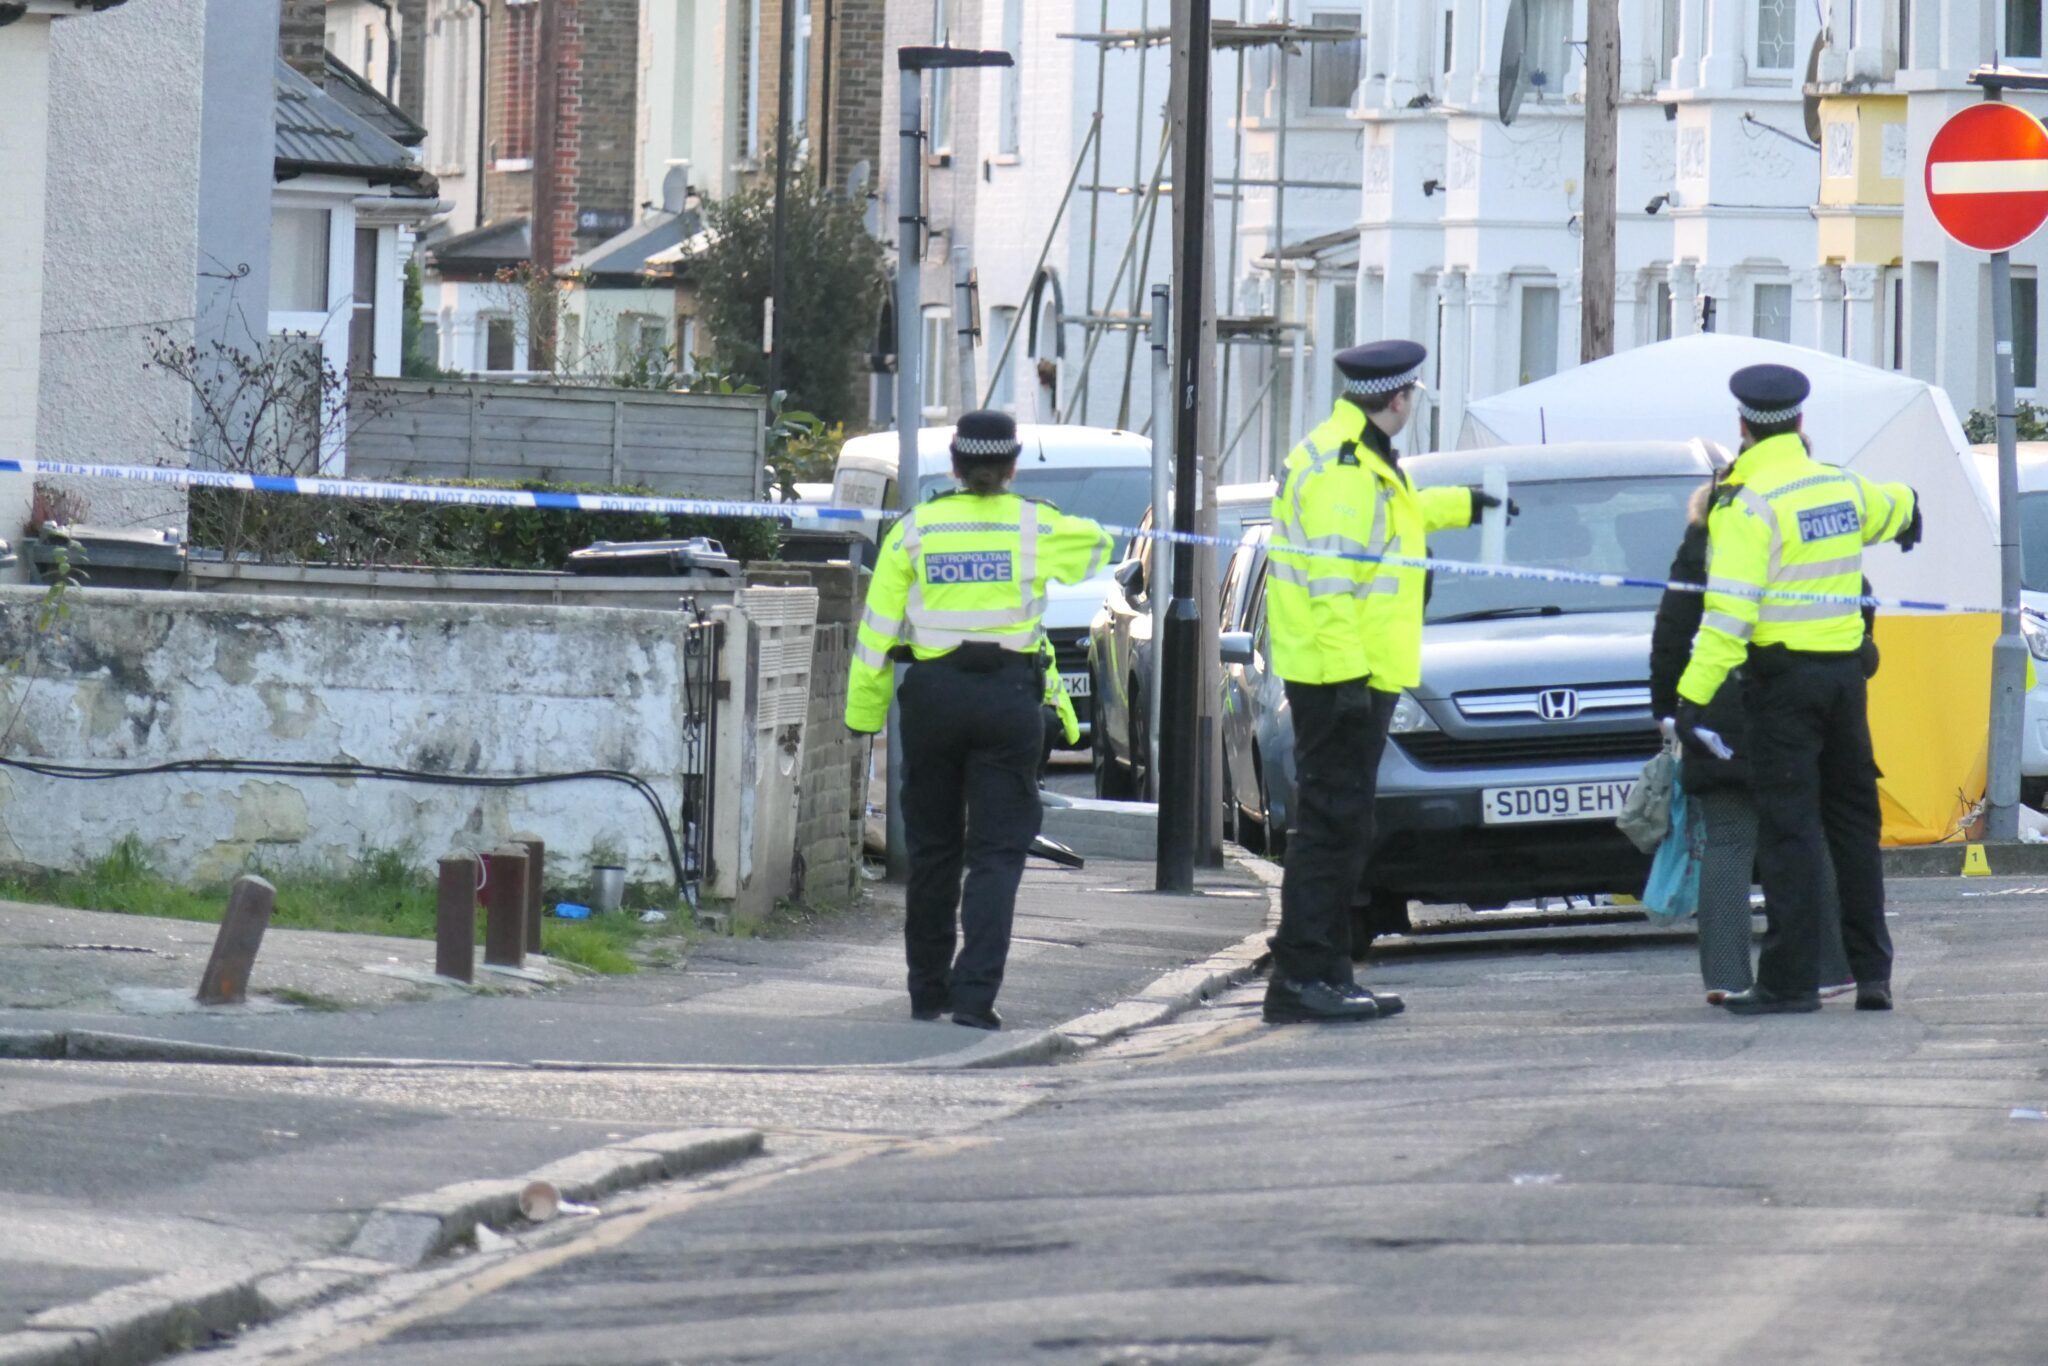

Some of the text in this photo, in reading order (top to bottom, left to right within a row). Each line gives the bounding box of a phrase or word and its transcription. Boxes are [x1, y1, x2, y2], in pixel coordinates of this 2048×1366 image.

[1801, 510, 1859, 540] POLICE
[926, 551, 1011, 564] METROPOLITAN
[927, 562, 1011, 582] POLICE
